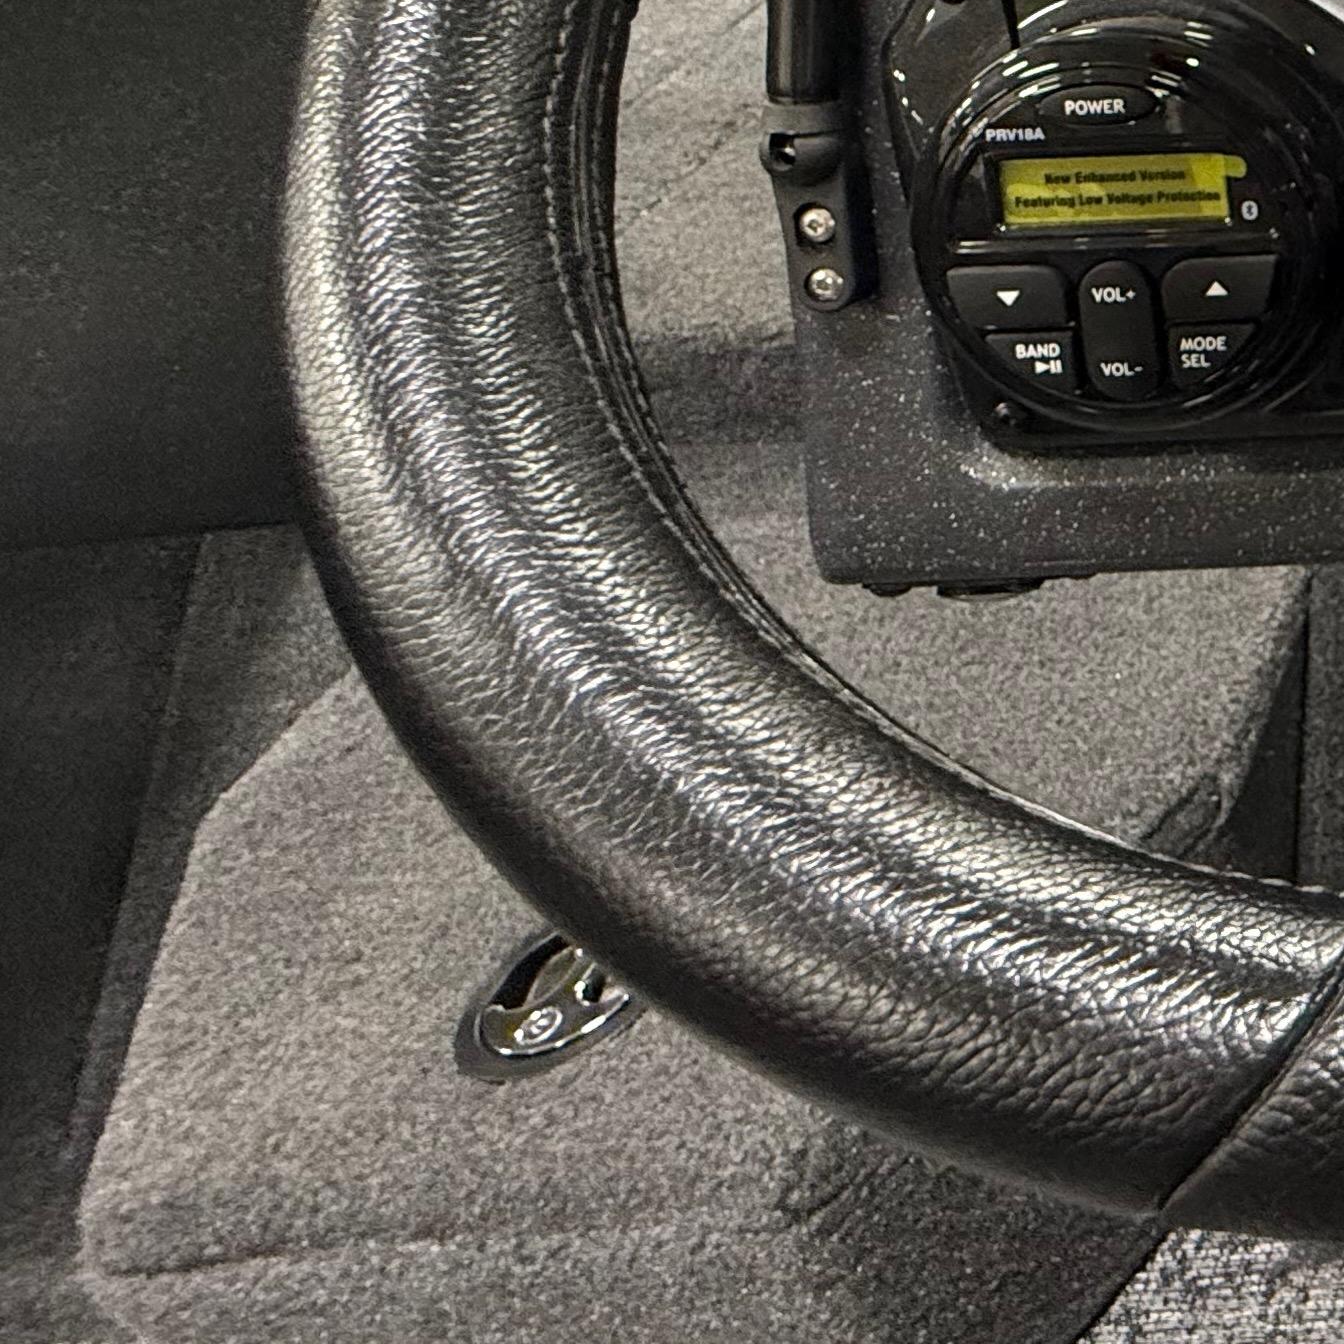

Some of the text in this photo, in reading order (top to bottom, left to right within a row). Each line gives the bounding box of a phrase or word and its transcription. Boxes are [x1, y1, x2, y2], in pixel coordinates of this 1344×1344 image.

[1064, 99, 1126, 116] POWER
[1044, 169, 1186, 185] New Enhanced Version
[1014, 189, 1221, 209] Featuring Low Voltage Protection
[1091, 287, 1136, 303] VOL+
[1015, 343, 1061, 359] BAND
[1180, 336, 1227, 351] MODE
[1181, 354, 1211, 368] SEL
[1100, 362, 1144, 377] VOL-
